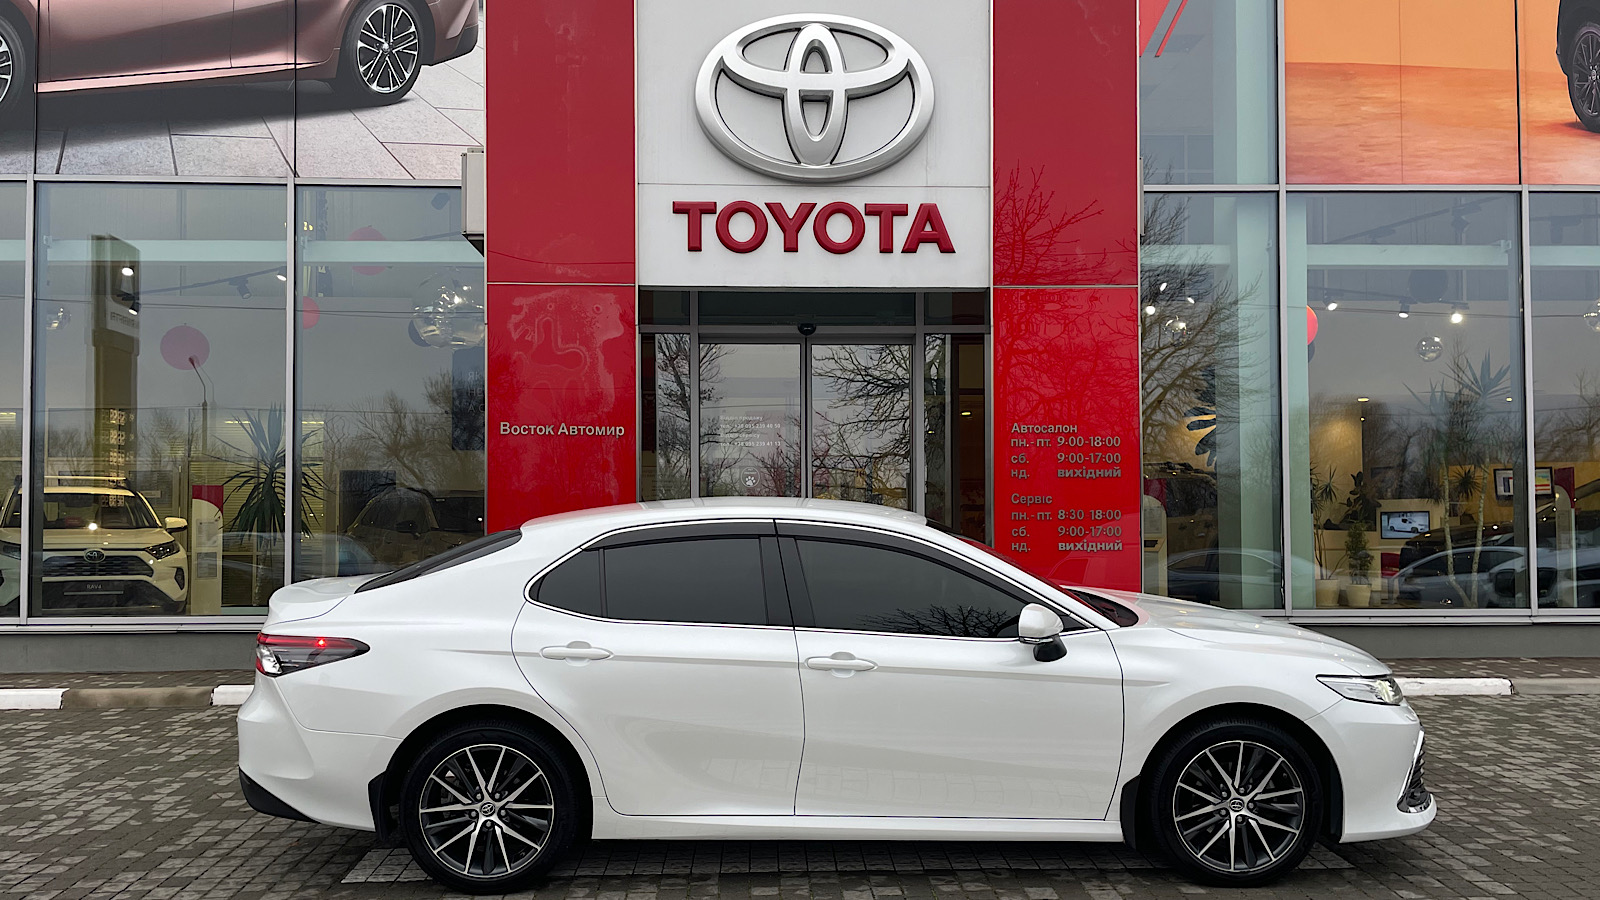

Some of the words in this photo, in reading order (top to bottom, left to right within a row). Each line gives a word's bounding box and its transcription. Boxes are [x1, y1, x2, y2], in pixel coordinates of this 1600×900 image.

[672, 200, 957, 255] TOYOTA
[499, 421, 555, 435] Восток
[557, 422, 625, 439] Автомир
[1011, 422, 1078, 434] Автосалон
[1010, 452, 1030, 464] сб.
[1056, 452, 1122, 464] 9:00-17:00
[1010, 468, 1030, 479] нд.
[1057, 466, 1122, 479] вихідний
[1011, 526, 1030, 537] сб.
[1057, 525, 1122, 537] 9:00-17:00
[1011, 542, 1031, 552] нд.
[1058, 539, 1123, 552] вихідний
